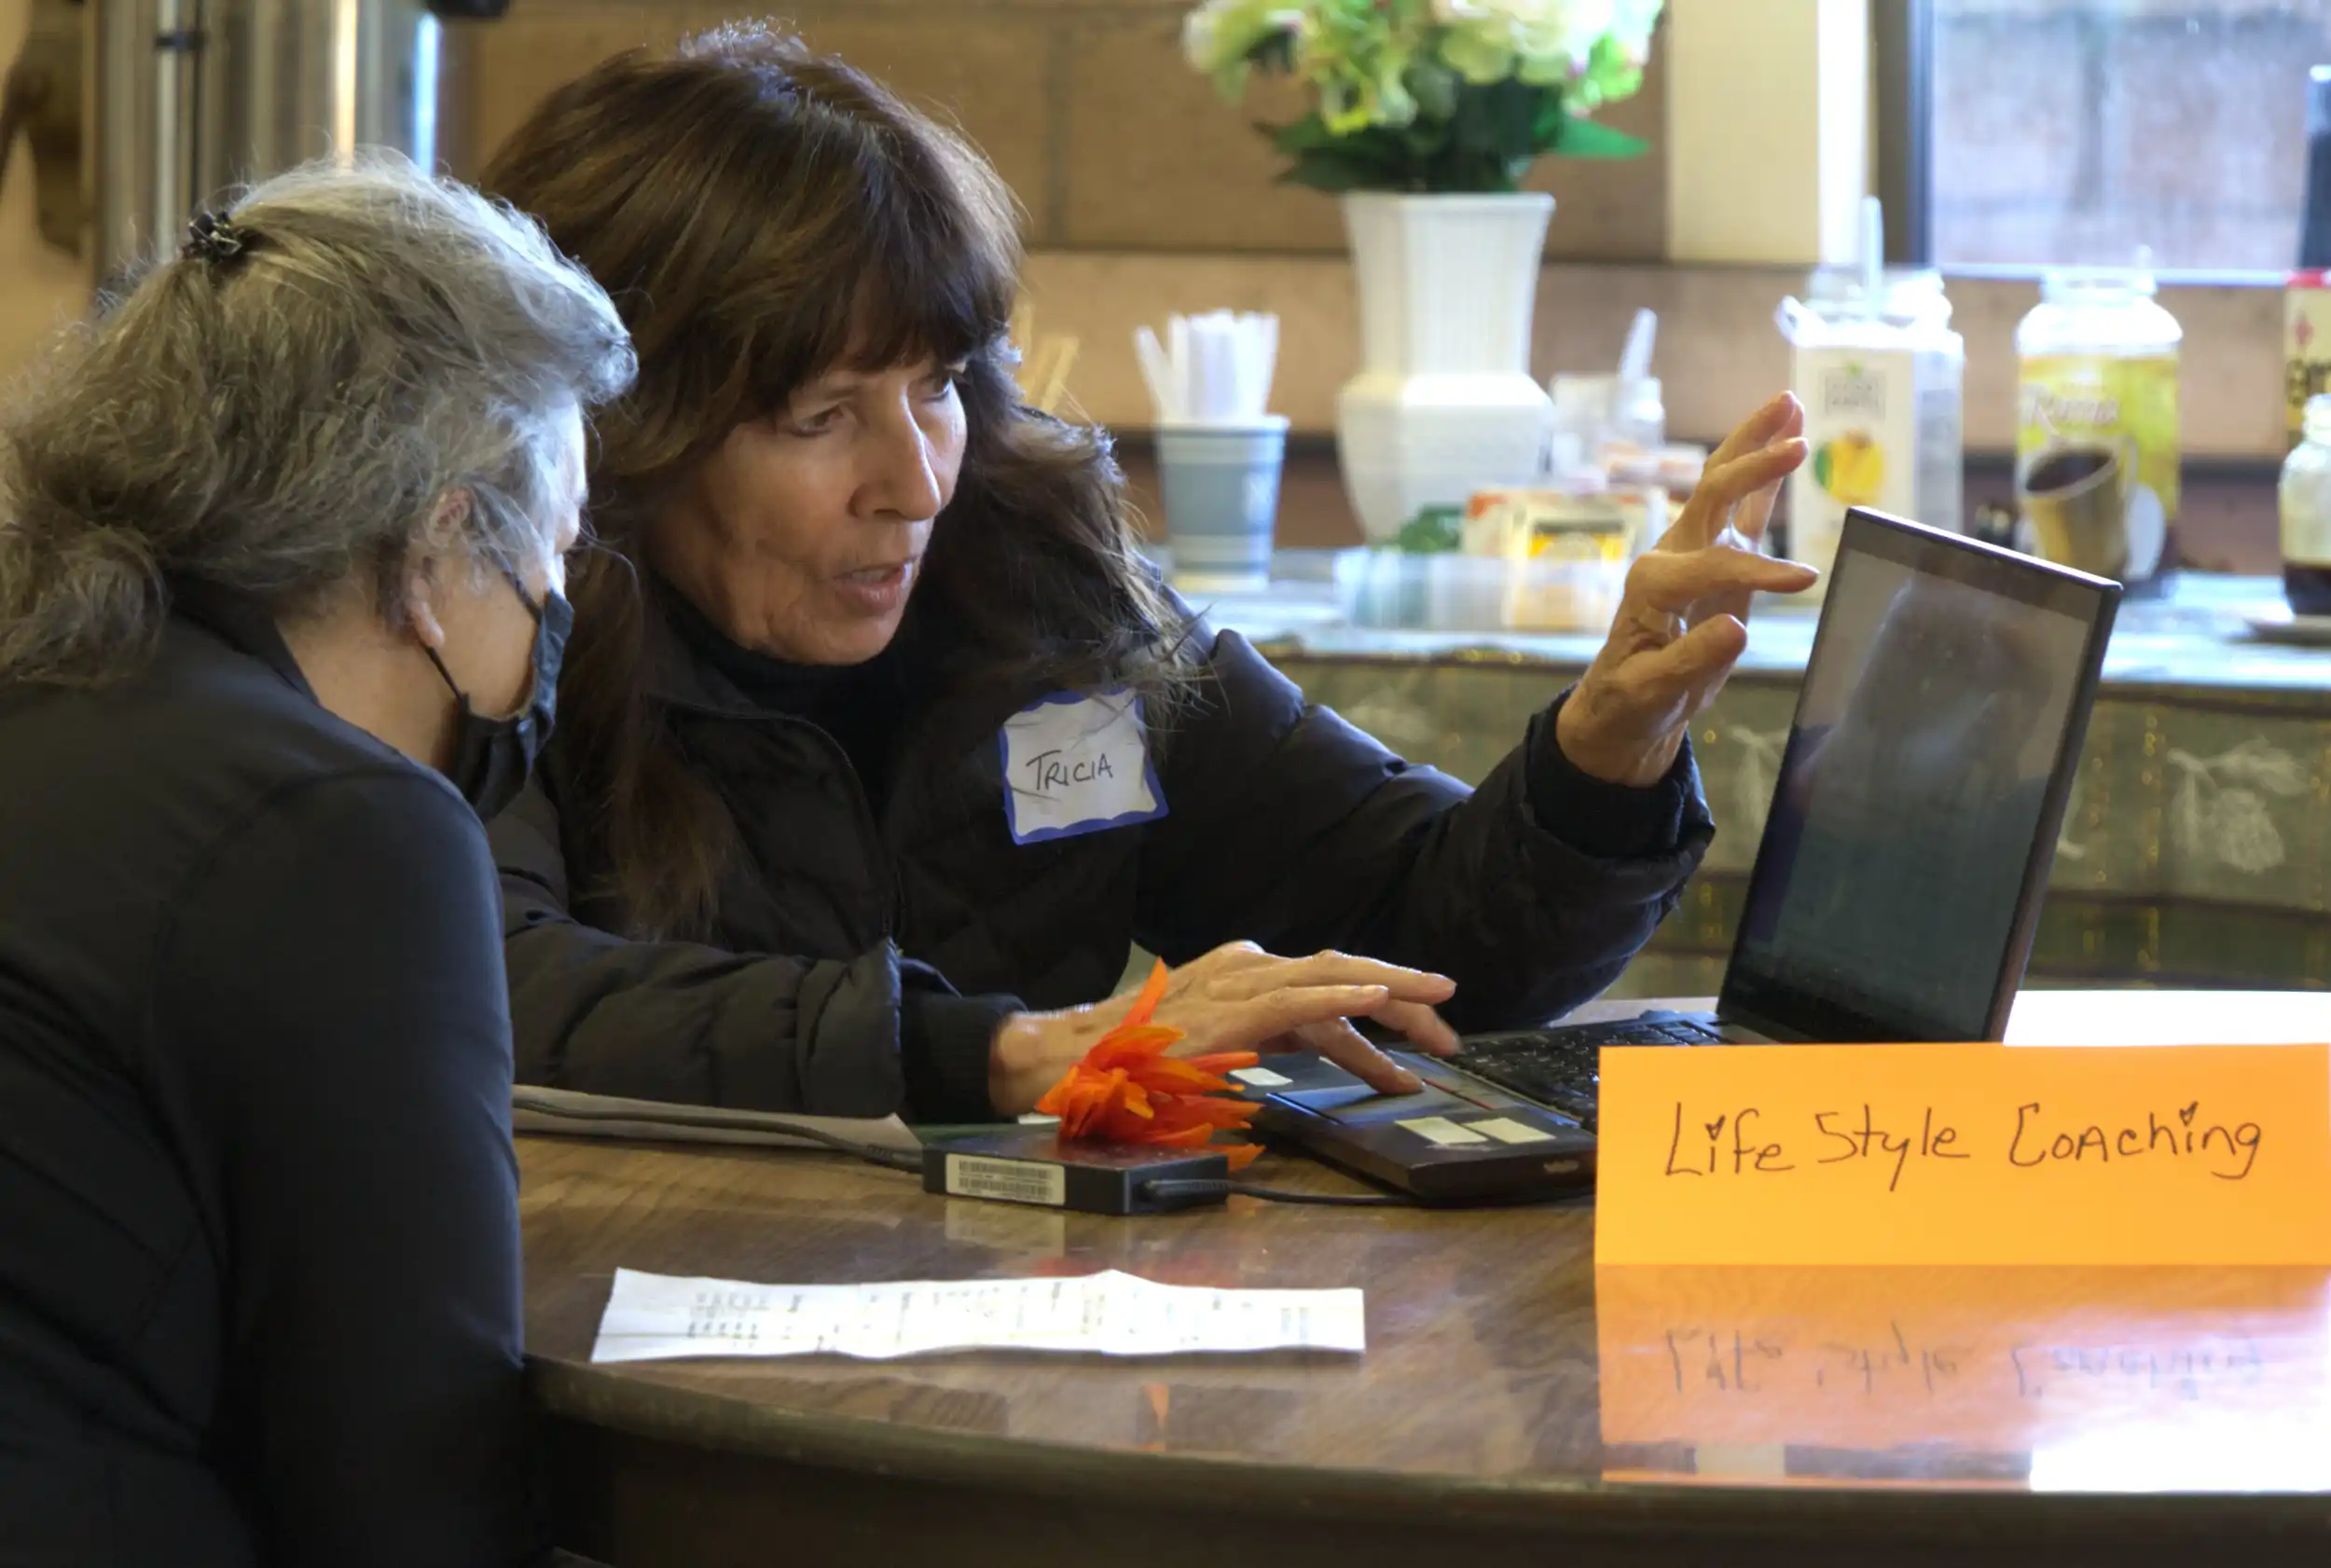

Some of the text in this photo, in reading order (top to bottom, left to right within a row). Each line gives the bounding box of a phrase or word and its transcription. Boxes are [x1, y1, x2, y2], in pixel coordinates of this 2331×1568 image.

[1026, 750, 1113, 791] TRICIA
[1665, 1102, 1795, 1176] Life
[1815, 1104, 1970, 1192] Style
